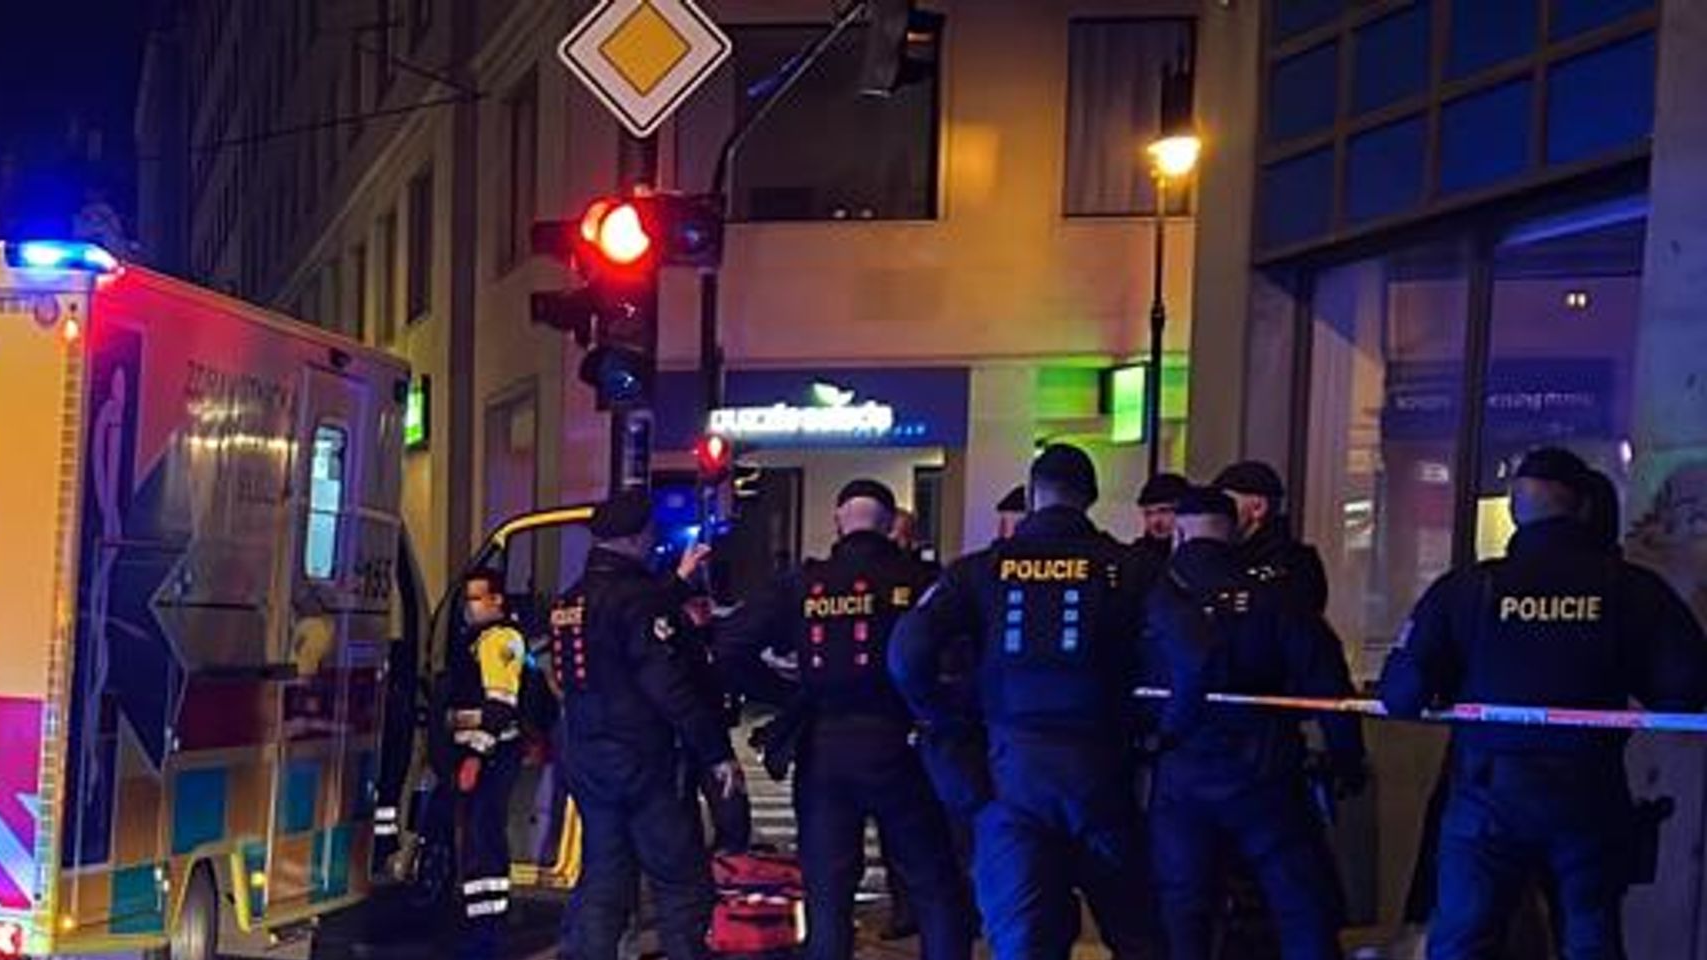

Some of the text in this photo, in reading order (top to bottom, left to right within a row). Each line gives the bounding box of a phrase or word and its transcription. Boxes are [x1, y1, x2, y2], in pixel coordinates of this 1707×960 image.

[1001, 559, 1089, 581] POLICIE
[803, 593, 874, 619] POLICIE
[1500, 596, 1602, 621] POLICIE
